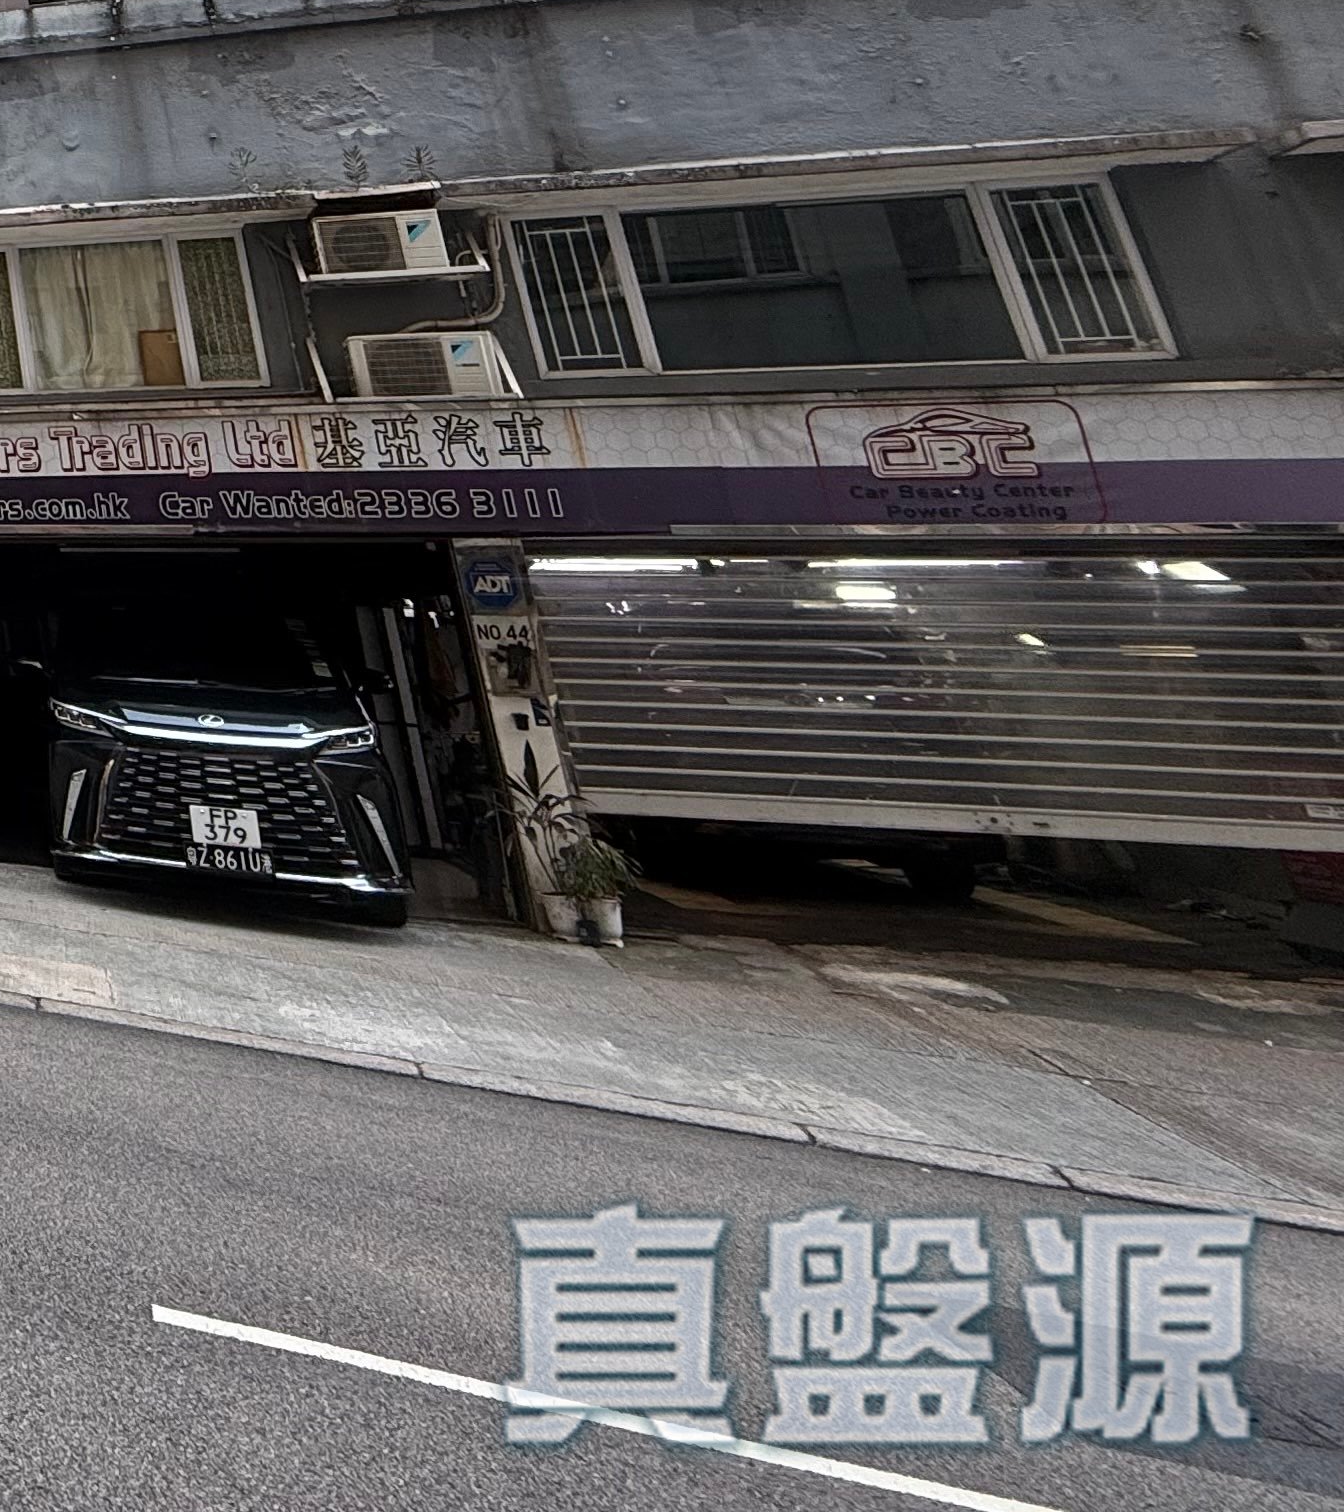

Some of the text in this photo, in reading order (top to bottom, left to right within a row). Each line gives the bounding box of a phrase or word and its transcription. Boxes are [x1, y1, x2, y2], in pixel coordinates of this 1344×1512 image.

[48, 422, 211, 479] Trading
[221, 419, 297, 468] Ltd
[312, 411, 551, 468] 基亞汽車
[863, 434, 1040, 480] CBC
[849, 483, 1074, 501] Car Beauty Center
[159, 491, 214, 519] Car
[473, 488, 565, 519] 3111
[885, 504, 1067, 521] Power Coating
[473, 575, 511, 593] ADT
[209, 808, 237, 826] FP
[204, 823, 247, 844] 379
